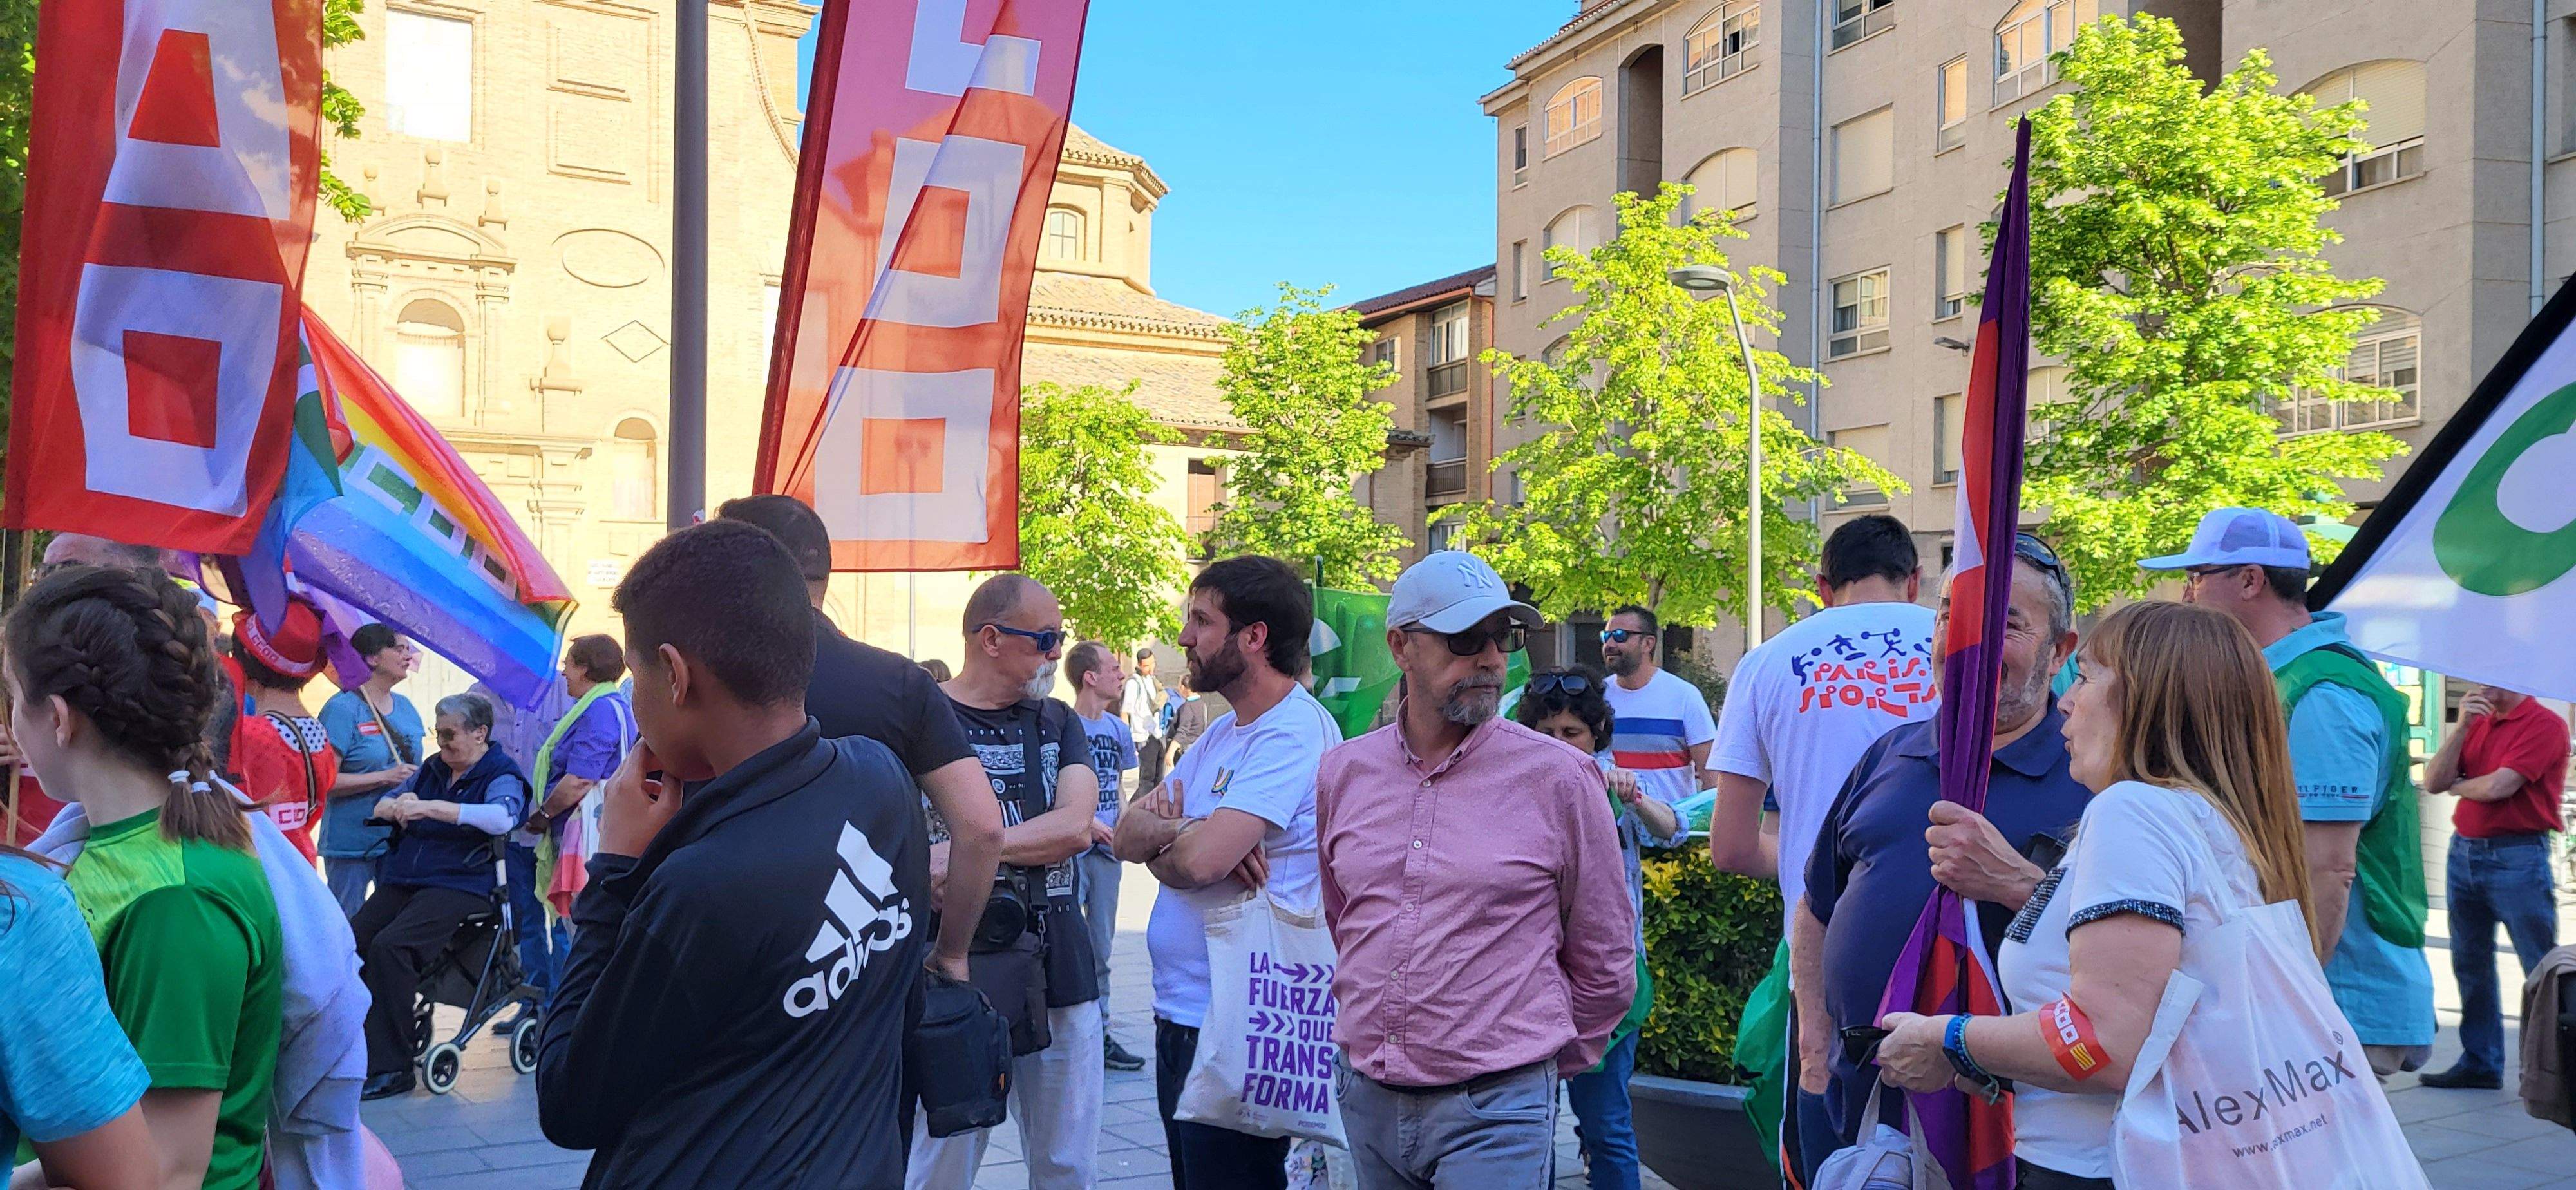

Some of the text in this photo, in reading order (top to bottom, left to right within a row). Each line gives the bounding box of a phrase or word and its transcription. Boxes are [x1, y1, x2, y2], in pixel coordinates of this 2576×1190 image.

[2298, 785, 2358, 793] ILFIGER
[1250, 952, 1271, 975] LA
[1249, 978, 1336, 1017] FUERZA
[1299, 1019, 1335, 1043] QUE
[1246, 1035, 1334, 1079] TRANS
[1241, 1073, 1329, 1115] FORMA
